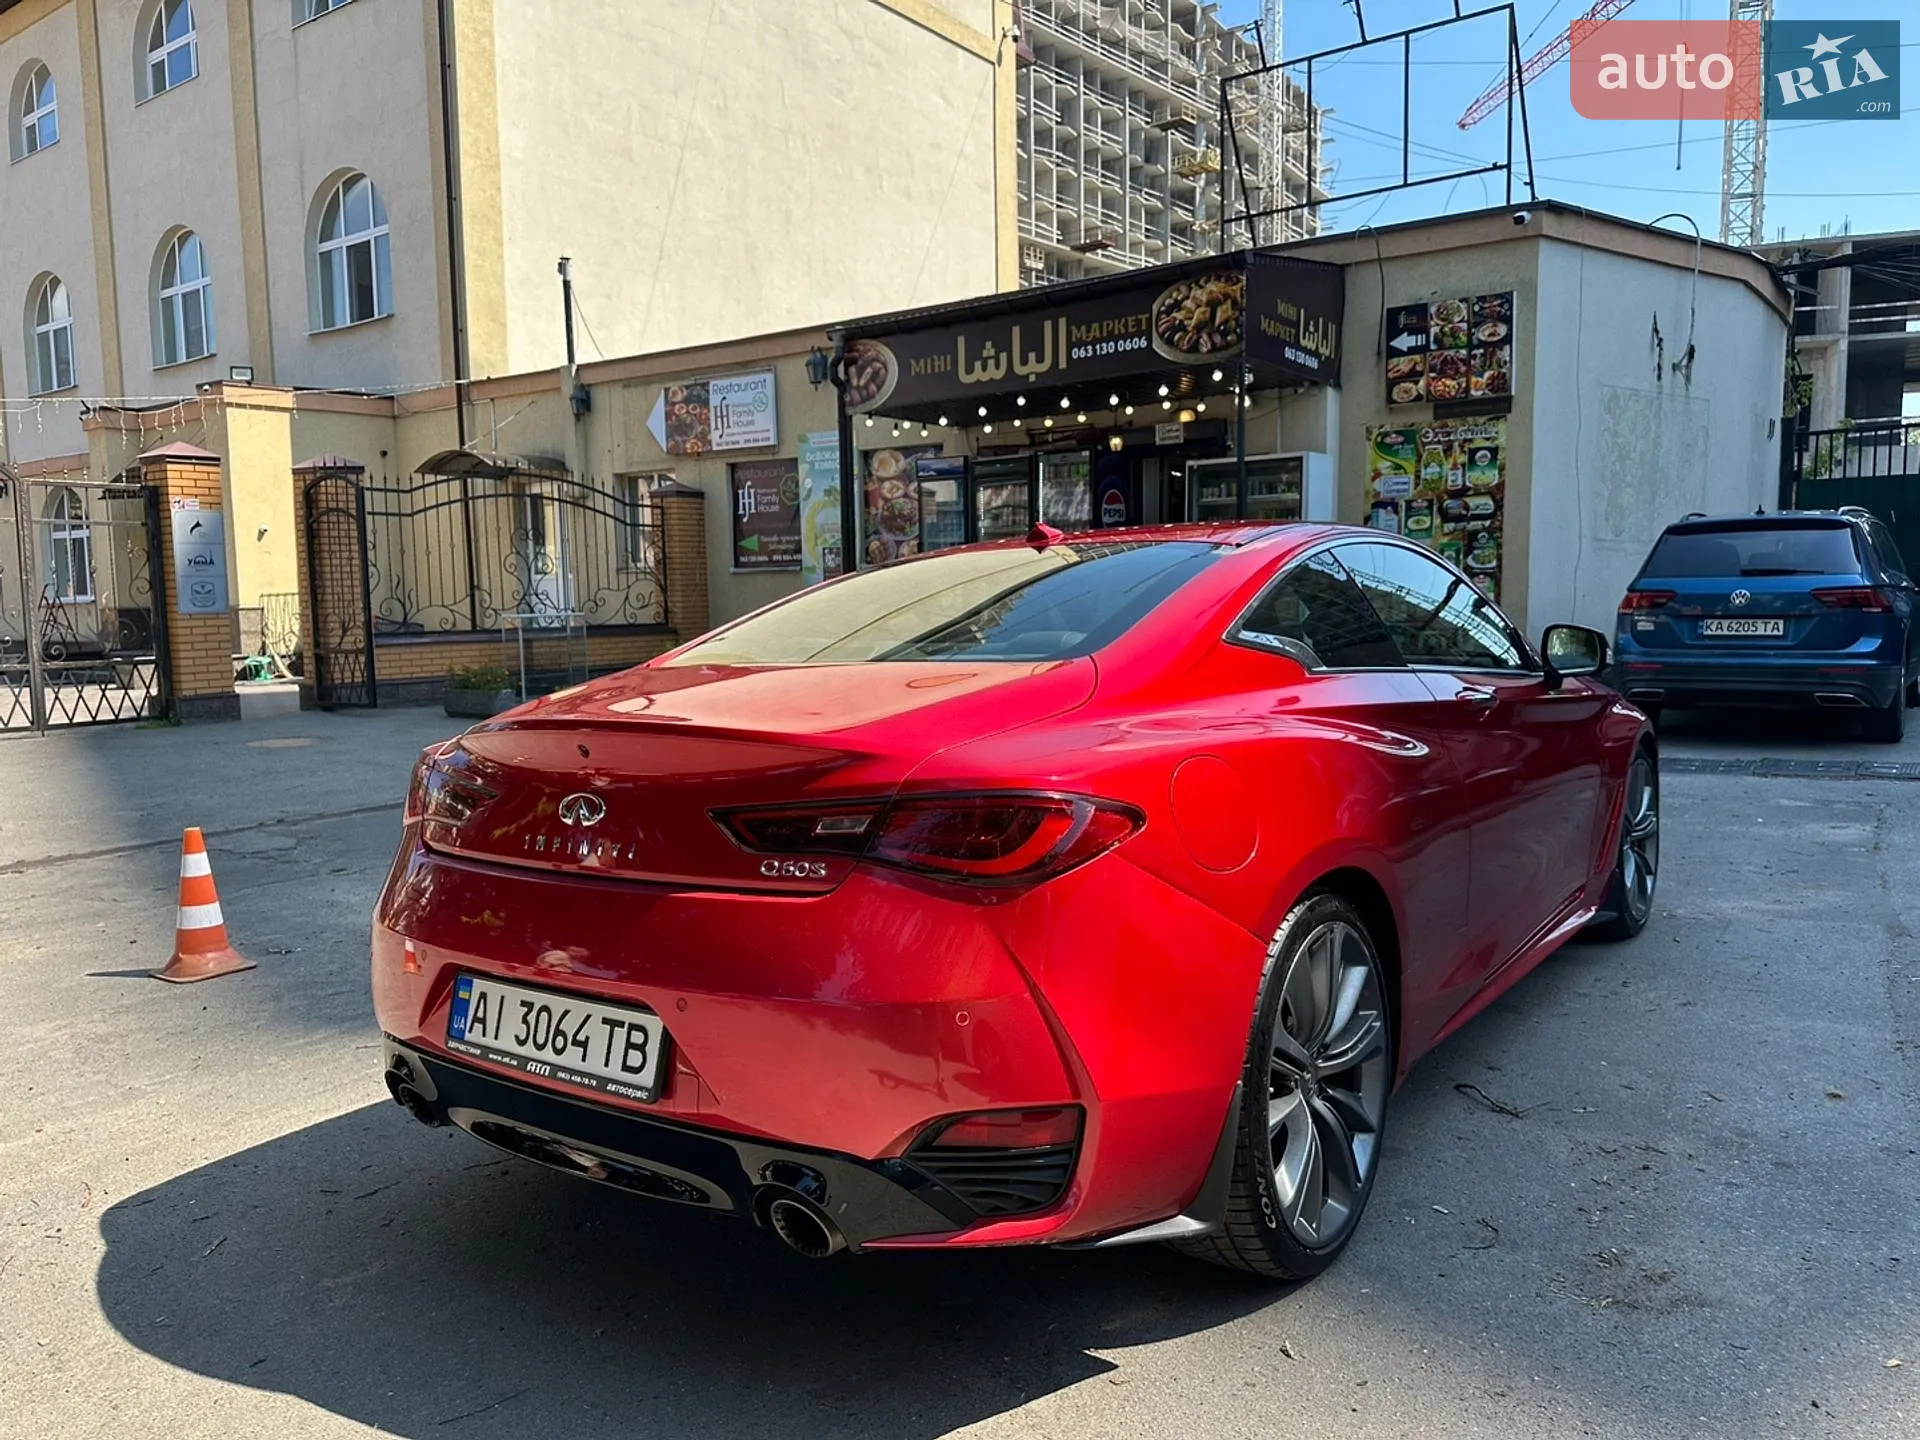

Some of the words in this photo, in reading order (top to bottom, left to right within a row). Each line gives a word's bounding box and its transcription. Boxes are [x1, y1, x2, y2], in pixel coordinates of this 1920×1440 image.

[1071, 313, 1149, 342] МАРКЕТ
[957, 316, 1067, 384] الباشا
[1071, 347, 1093, 360] 063
[1096, 342, 1115, 356] 130
[1117, 336, 1148, 352] 0606
[712, 379, 767, 396] Restaurant
[757, 494, 779, 504] Family
[1705, 621, 1724, 633] KA
[1726, 621, 1758, 633] 6205
[1761, 621, 1780, 633] TA
[760, 859, 827, 878] Q60S
[453, 1015, 465, 1030] UA
[468, 991, 505, 1041] AI
[514, 1000, 593, 1063] 3064
[601, 1016, 649, 1075] TB
